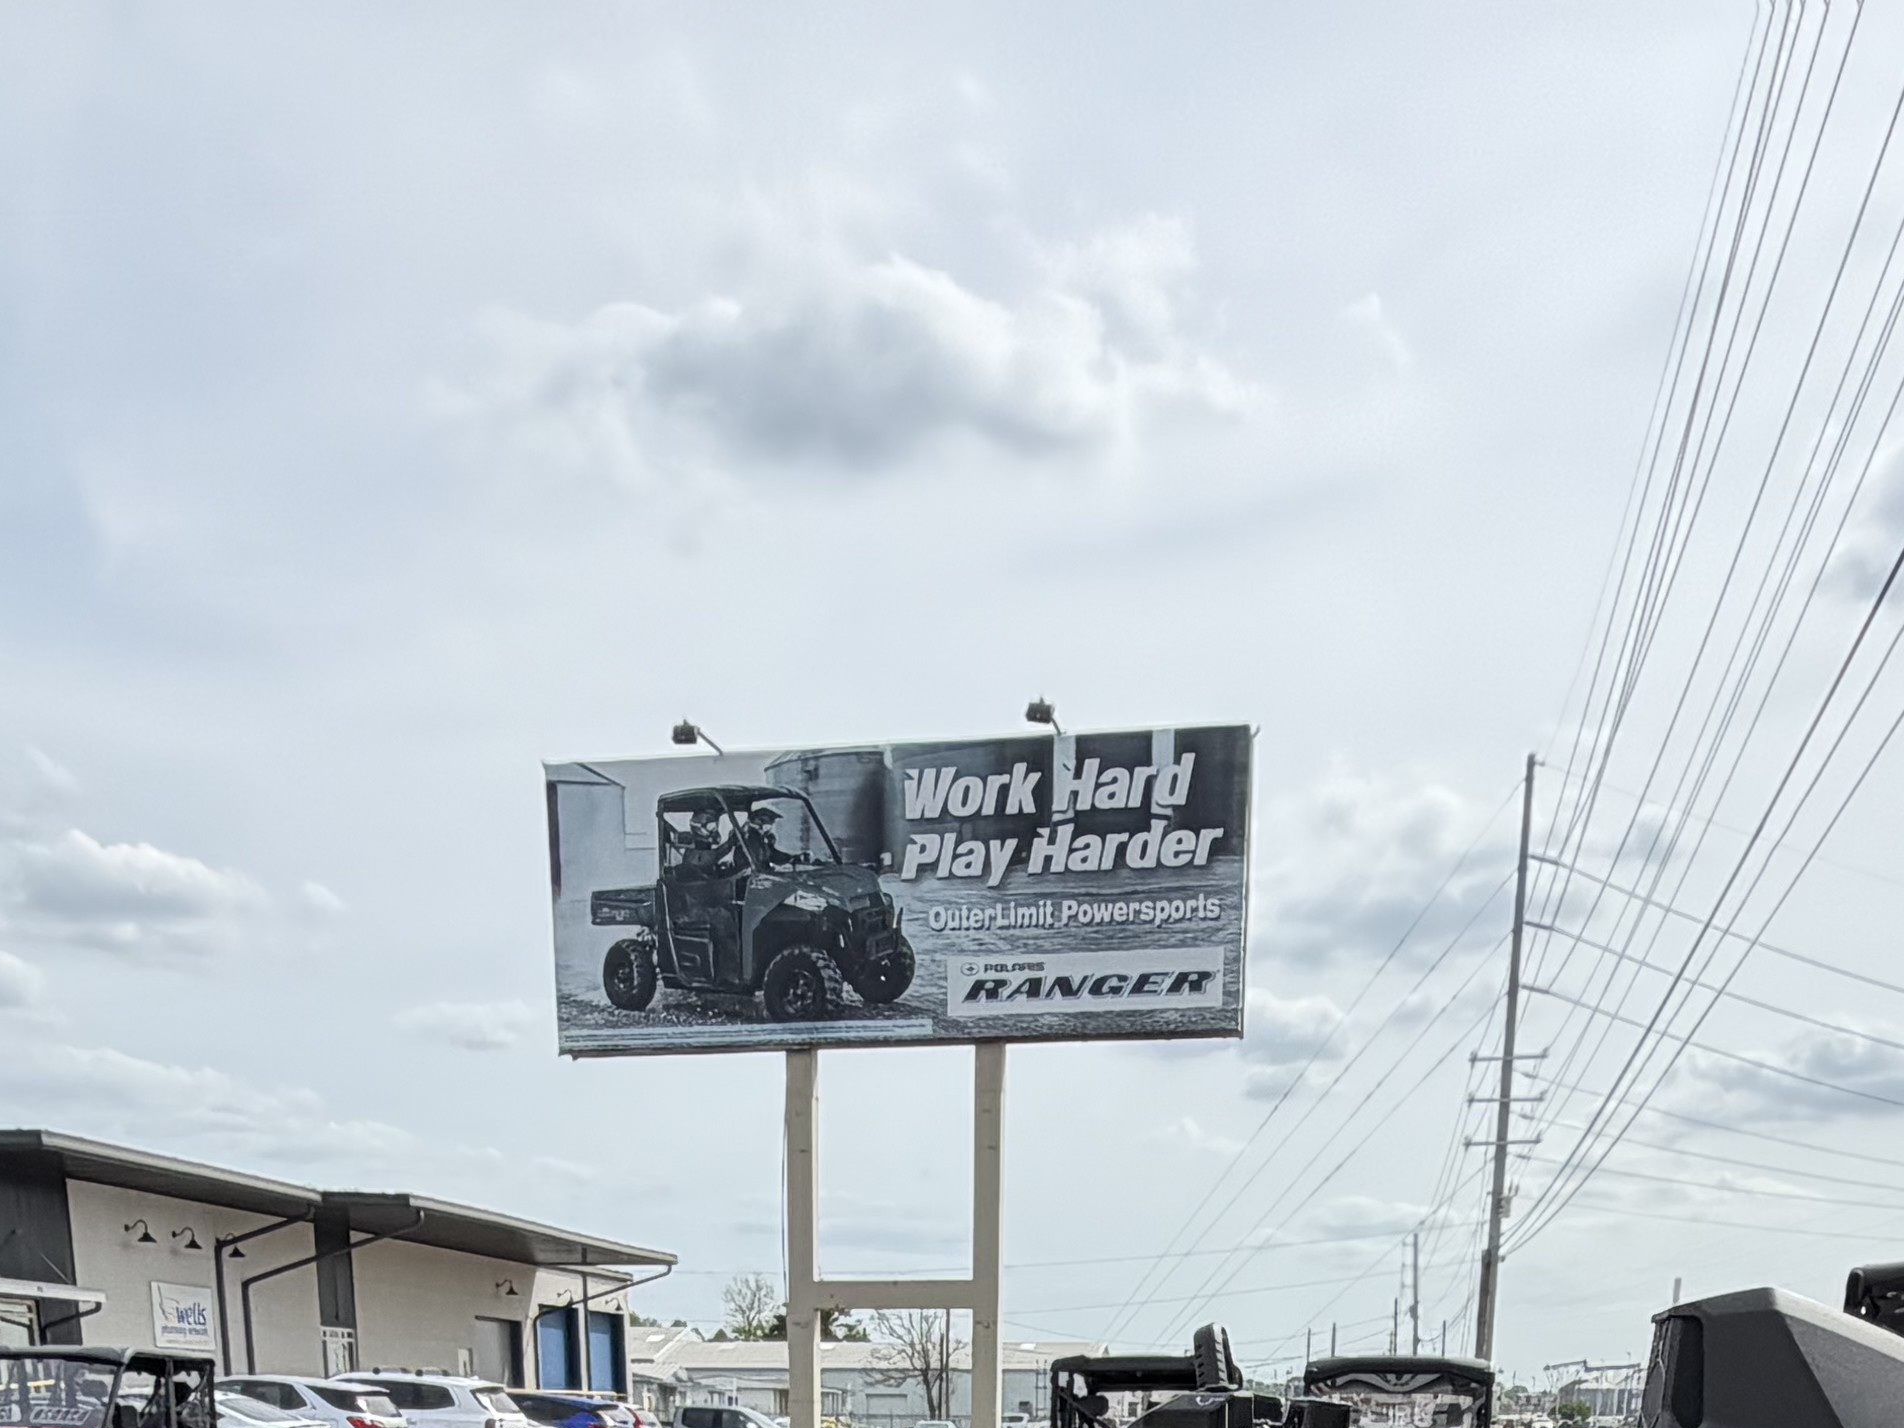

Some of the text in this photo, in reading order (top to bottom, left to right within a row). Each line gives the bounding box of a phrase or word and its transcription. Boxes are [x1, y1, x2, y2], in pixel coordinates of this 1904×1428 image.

[904, 752, 1196, 820] Work Hard
[900, 819, 1224, 888] Play Harder
[1061, 893, 1222, 928] Powersports
[983, 961, 1046, 974] POLARIS
[962, 971, 1218, 1004] RANGER
[175, 1302, 207, 1326] wells
